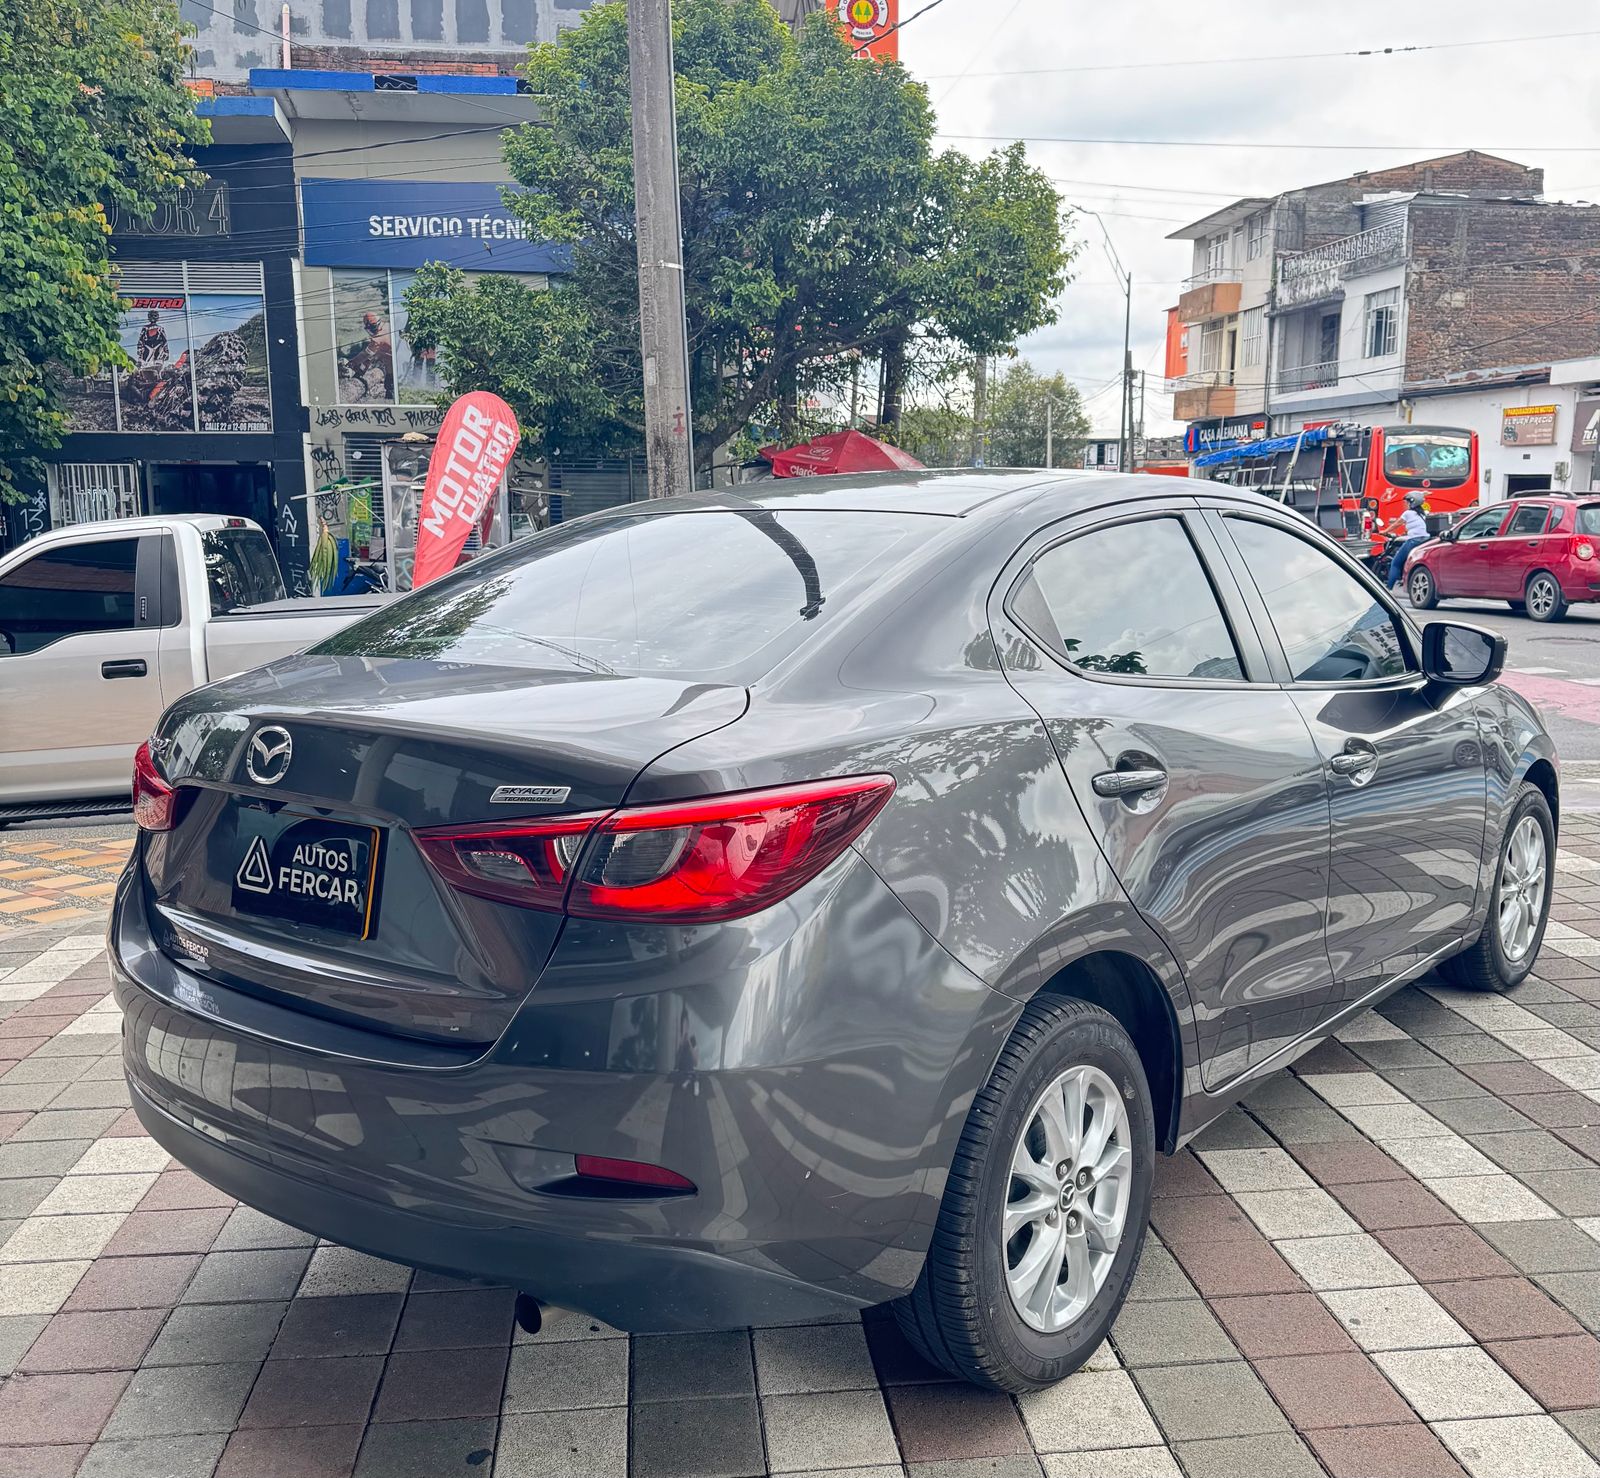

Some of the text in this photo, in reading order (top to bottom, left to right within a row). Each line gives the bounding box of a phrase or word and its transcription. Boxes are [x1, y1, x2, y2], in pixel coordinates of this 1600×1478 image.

[208, 186, 228, 235] 4
[368, 214, 463, 238] SERVICIO
[1200, 429, 1216, 442] CASA
[1216, 424, 1248, 440] ALEMANA
[422, 404, 515, 539] MOTOR CUATRO
[790, 465, 815, 476] Claro
[500, 787, 562, 795] SKYACTIV
[292, 844, 349, 872] AUTOS
[278, 866, 359, 904] FERCAR
[186, 939, 209, 958] FERCAR
